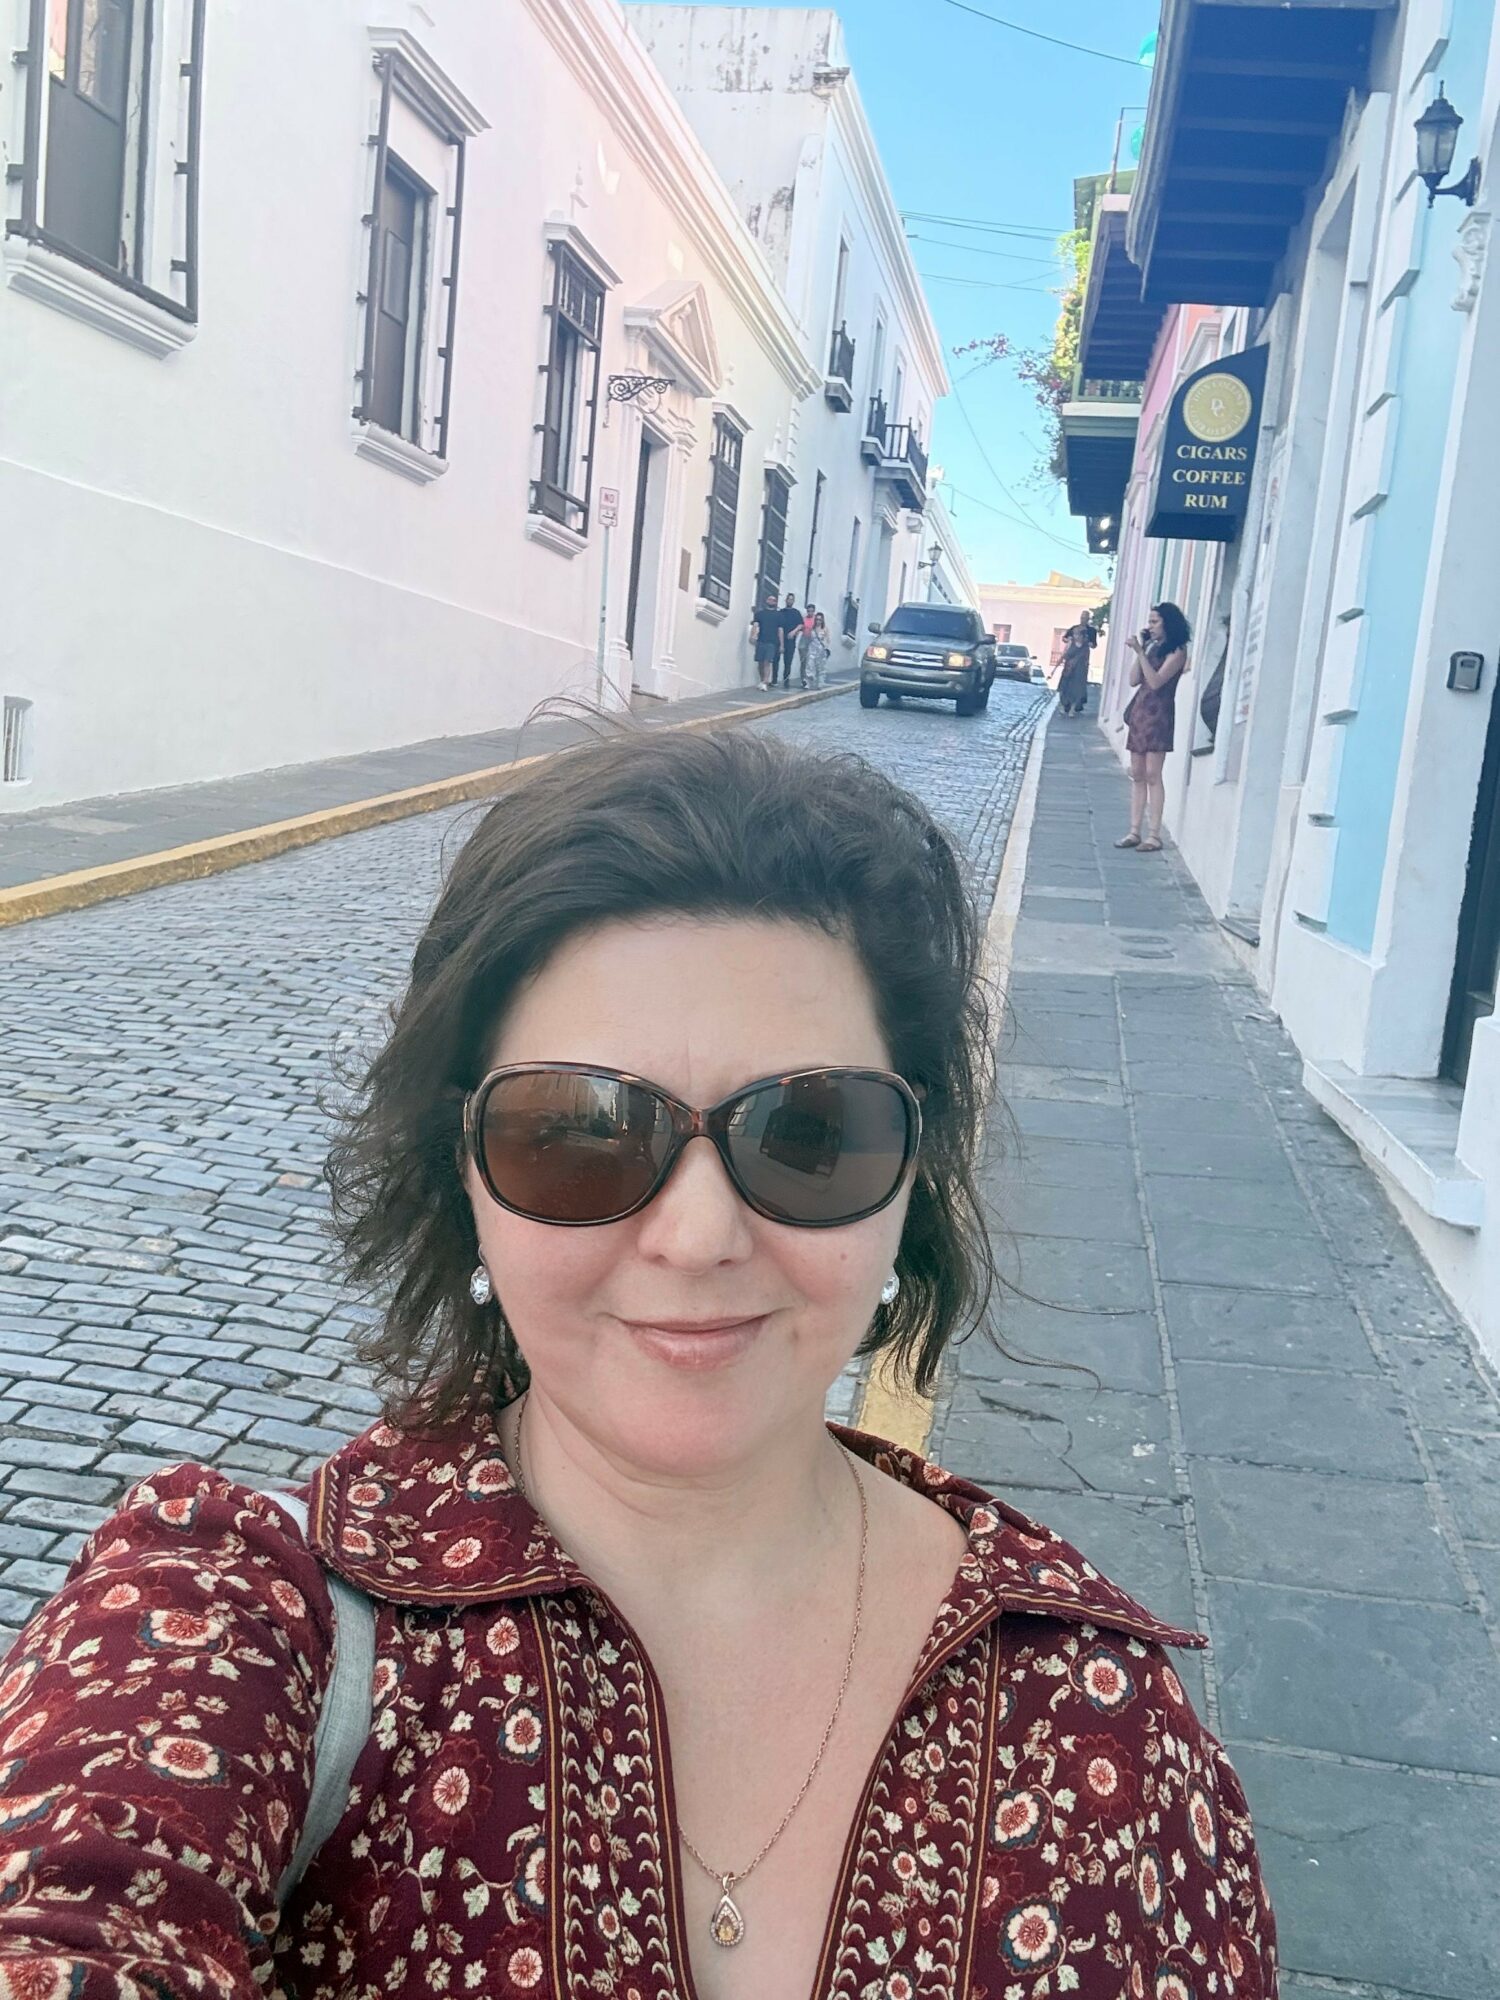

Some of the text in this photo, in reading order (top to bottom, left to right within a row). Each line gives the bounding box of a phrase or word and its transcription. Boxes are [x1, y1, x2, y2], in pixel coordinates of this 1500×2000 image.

[1177, 445, 1247, 460] CIGARS
[1173, 469, 1245, 484] COFFEE
[604, 493, 615, 503] NO
[1185, 494, 1228, 508] RUM
